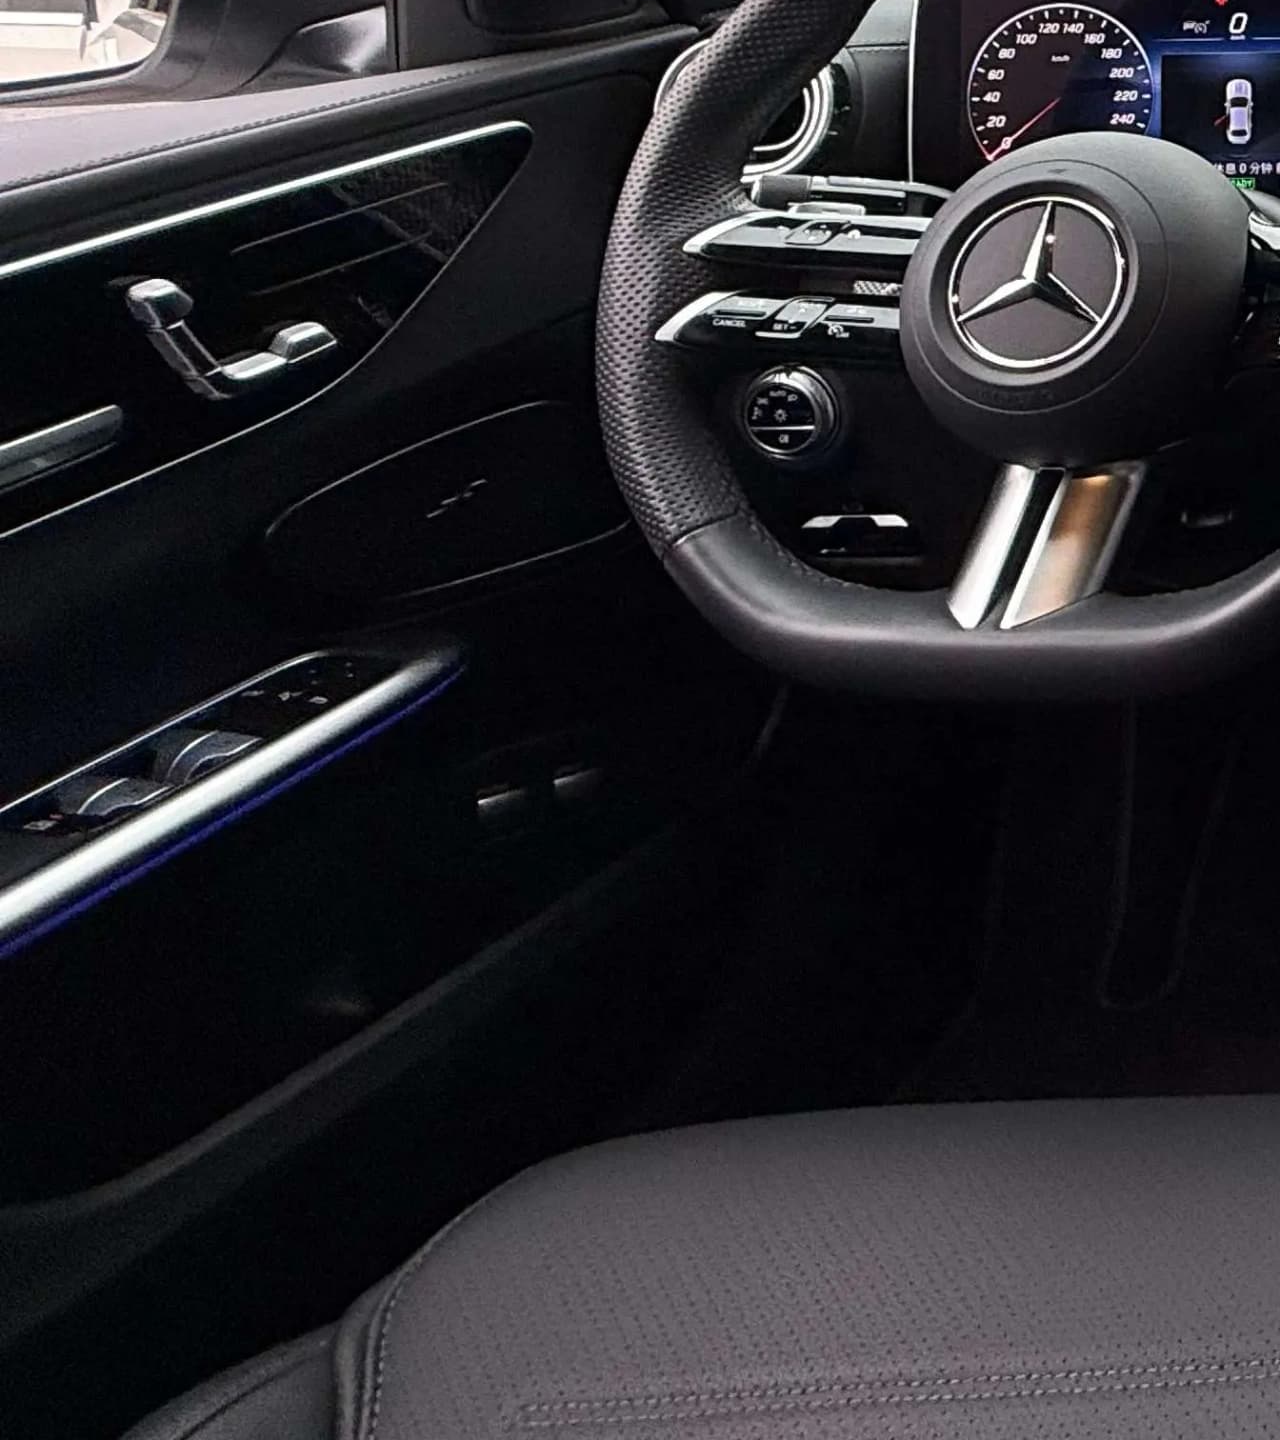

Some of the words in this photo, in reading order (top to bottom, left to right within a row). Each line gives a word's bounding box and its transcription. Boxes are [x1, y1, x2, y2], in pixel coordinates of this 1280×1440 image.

[1038, 22, 1060, 34] 120
[1062, 22, 1085, 34] 140
[1229, 12, 1248, 34] 0
[1015, 33, 1037, 45] 100
[1083, 33, 1106, 45] 160
[998, 48, 1016, 59] 80
[1101, 48, 1122, 59] 180
[987, 69, 1005, 80] 60
[1109, 67, 1134, 78] 200
[982, 91, 1001, 103] 40
[1113, 90, 1138, 101] 220
[986, 115, 1007, 127] 20
[1110, 113, 1136, 125] 240
[1239, 162, 1247, 174] 0
[1249, 162, 1273, 175] 分钟
[712, 318, 746, 328] CANCEL
